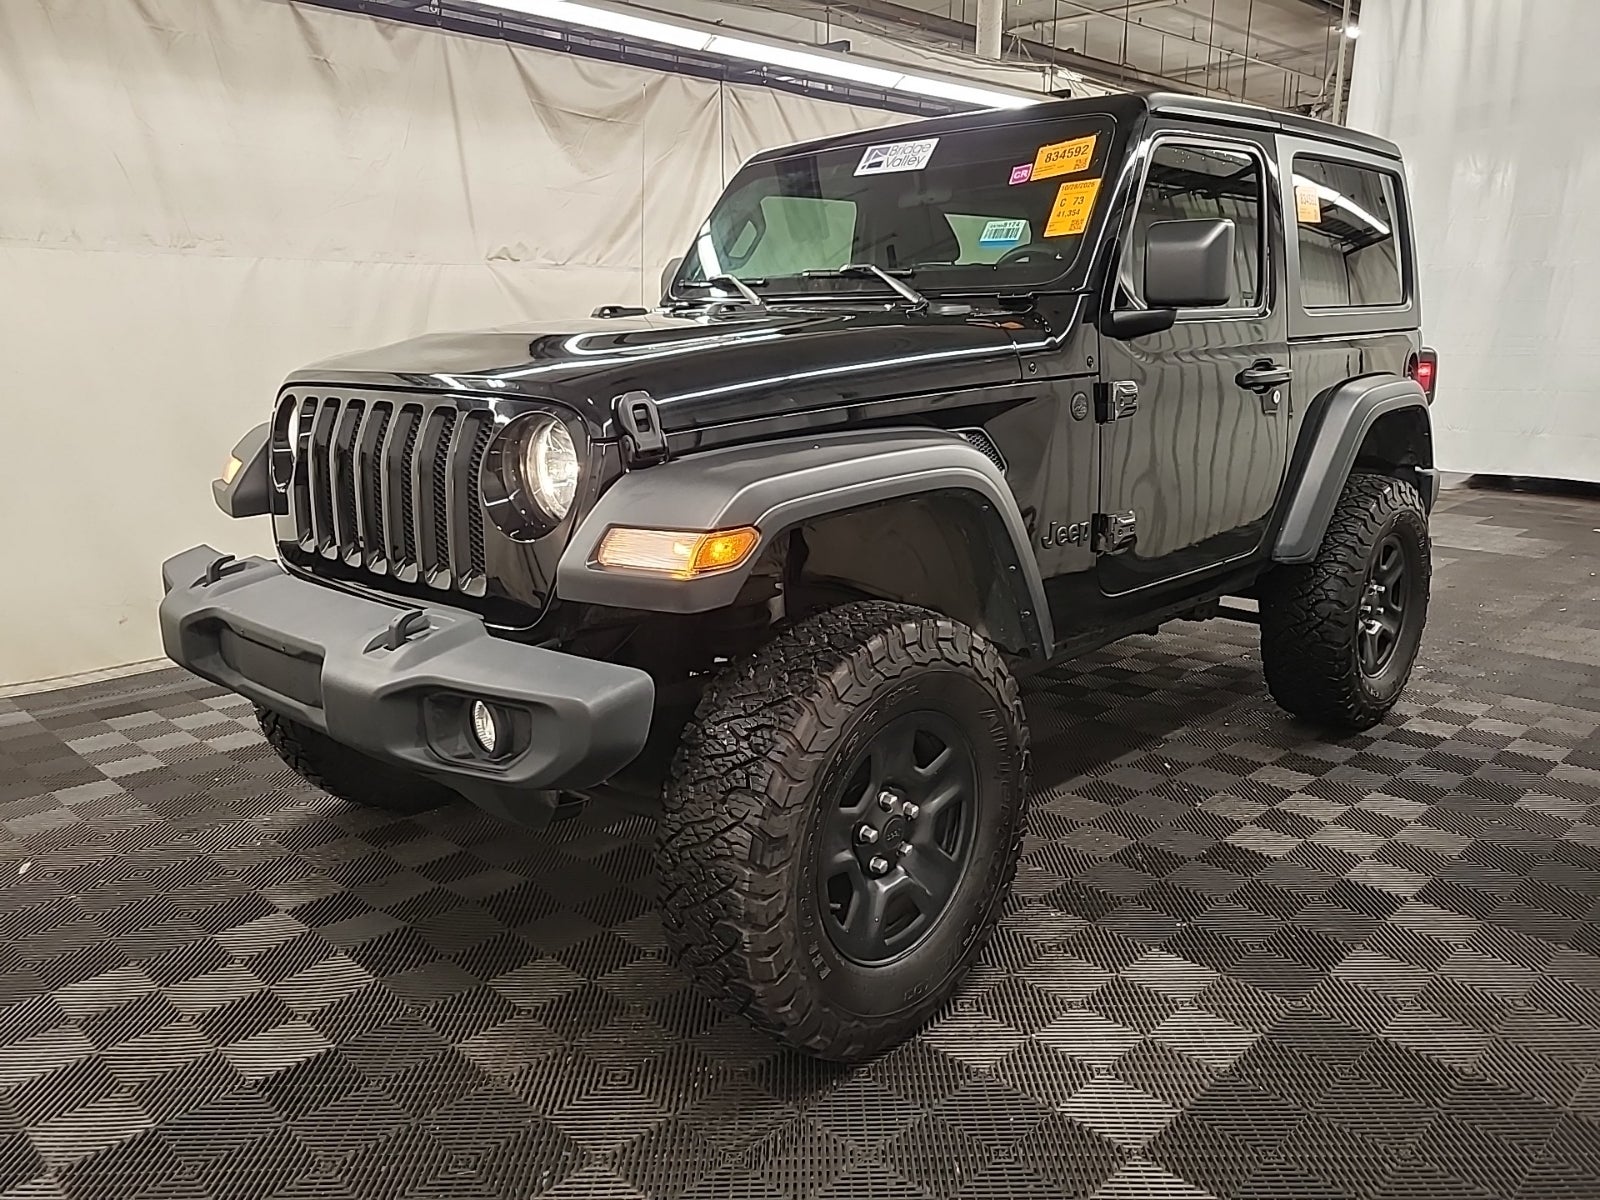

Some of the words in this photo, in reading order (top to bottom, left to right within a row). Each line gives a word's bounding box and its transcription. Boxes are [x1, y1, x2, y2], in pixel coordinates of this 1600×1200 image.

[888, 143, 932, 157] Bridge
[1044, 144, 1090, 164] 834592
[886, 155, 926, 168] Valley
[1013, 169, 1029, 179] CR
[1059, 197, 1067, 208] C
[1072, 196, 1085, 206] 73
[1040, 520, 1090, 549] Jeep
